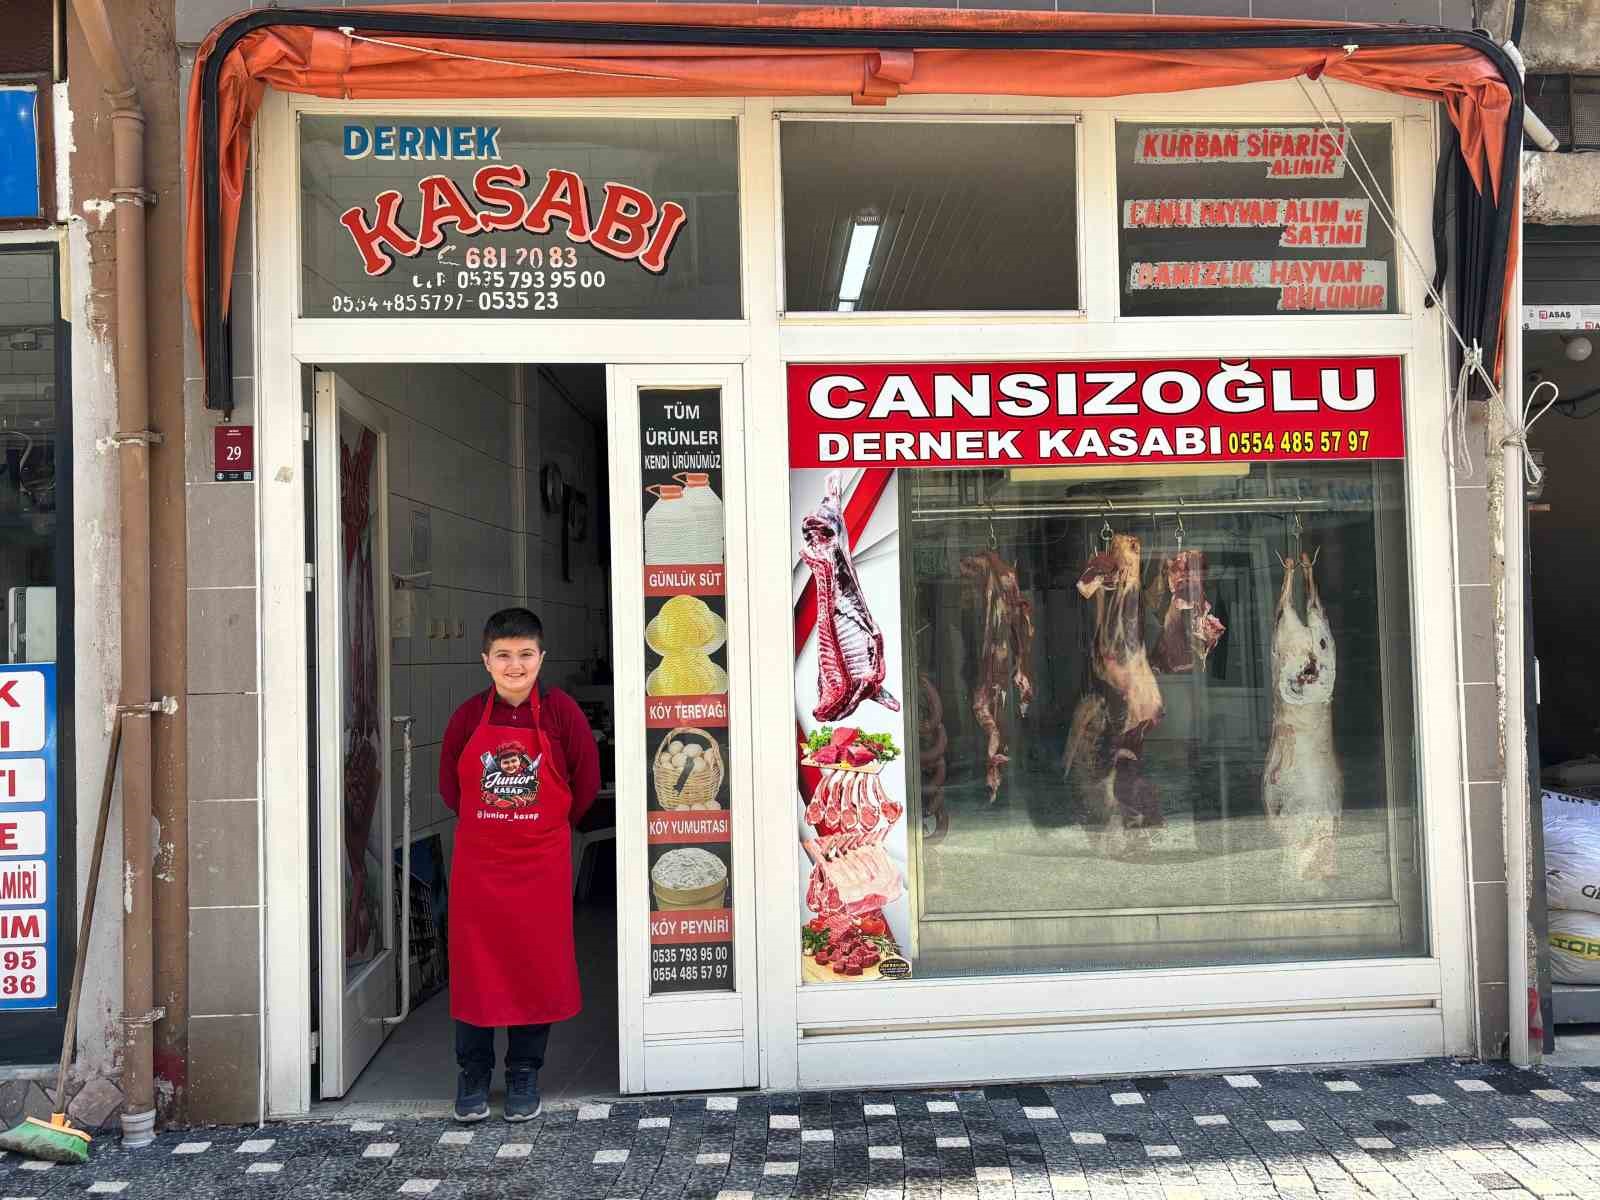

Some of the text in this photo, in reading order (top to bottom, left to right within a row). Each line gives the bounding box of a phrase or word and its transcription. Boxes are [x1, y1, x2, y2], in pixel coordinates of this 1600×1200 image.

[343, 125, 502, 161] DERNEK
[1143, 128, 1345, 159] KURBAN SİPARİŞİ
[1270, 159, 1335, 176] ALINIR
[1284, 200, 1339, 222] ALIM
[340, 165, 687, 277] KASABI
[465, 247, 507, 269] 681
[549, 246, 578, 269] 83
[457, 271, 505, 289] 0535
[508, 271, 545, 289] 793
[1270, 261, 1363, 283] HAYVAN
[478, 291, 533, 310] 0535
[534, 291, 559, 311] 23
[808, 360, 1377, 420] CANSIZOĞLU
[663, 401, 701, 420] TÜM
[645, 427, 719, 446] ÜRÜNLER
[818, 427, 1370, 462] DERNEK KASABI 0554 485 57 97
[226, 446, 242, 461] 29
[644, 451, 720, 470] KENDİ ÜRÜNÜMÜZ
[649, 569, 721, 587] GÜNLÜK SÜT
[650, 701, 727, 720] KÖY TEREYAĞI
[484, 771, 535, 788] Junior
[494, 786, 524, 794] KASAP
[650, 818, 728, 836] KÖY YUMURTASI
[651, 916, 729, 936] KÖY PEYNİRİ
[3, 950, 37, 971] 95
[652, 946, 728, 963] 0535 793 95 00
[652, 965, 728, 982] 0554 485 57 97
[3, 974, 36, 995] 36
